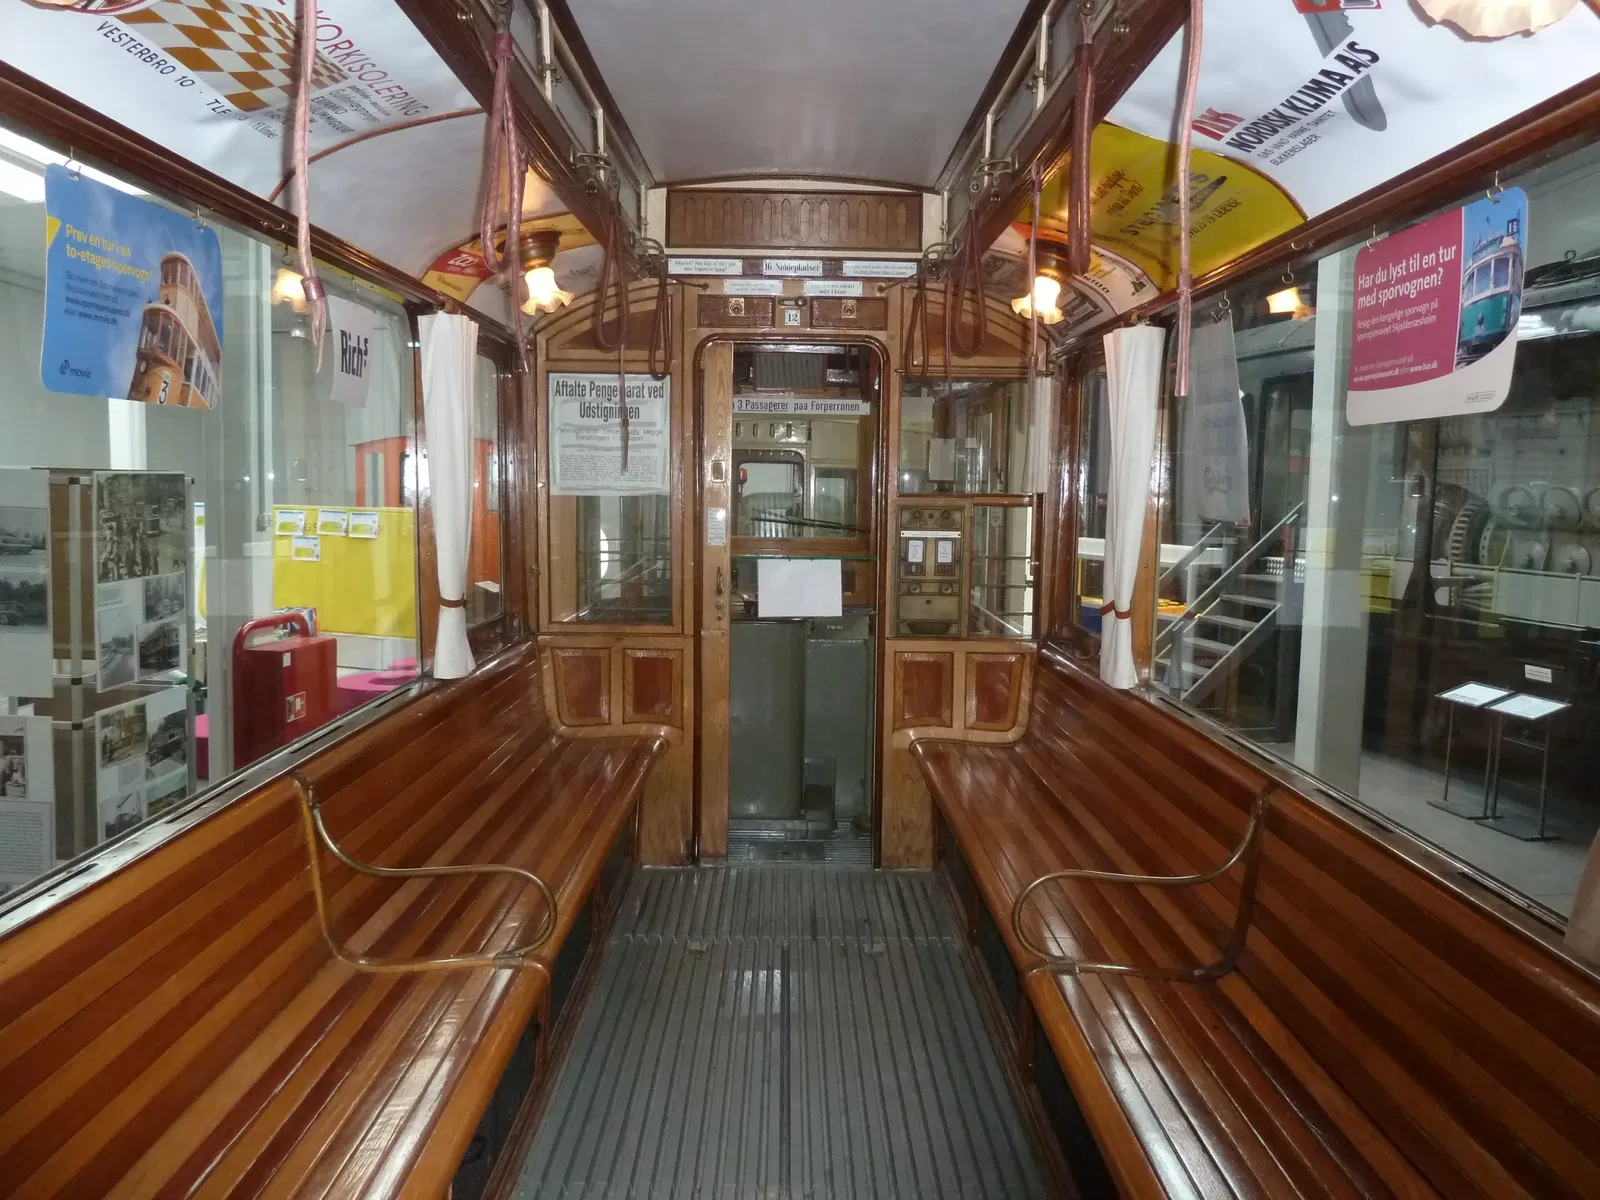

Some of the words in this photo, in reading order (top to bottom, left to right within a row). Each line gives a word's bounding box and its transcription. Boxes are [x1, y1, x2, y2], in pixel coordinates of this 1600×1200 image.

[96, 21, 177, 75] VESTERBRO
[174, 75, 196, 87] 10
[1224, 107, 1303, 154] NORDISK
[1279, 68, 1355, 116] KLIMA
[1333, 40, 1380, 75] A/S
[65, 223, 88, 244] Prøv
[88, 234, 101, 249] en
[102, 237, 115, 253] tur
[119, 244, 132, 258] en
[65, 243, 112, 272] to-etages
[111, 259, 153, 284] sporvogn!
[764, 263, 772, 271] 16
[775, 263, 820, 274] Siddepladser
[1358, 270, 1375, 291] Har
[1375, 265, 1388, 283] du
[1389, 260, 1407, 281] lyst
[1408, 253, 1421, 272] til
[1422, 252, 1436, 268] en
[1438, 245, 1457, 263] tur
[1357, 287, 1378, 310] med
[1378, 270, 1444, 307] sporvognen?
[788, 313, 798, 322] 12
[1370, 315, 1380, 325] den
[1404, 304, 1430, 319] sporvogn
[1430, 297, 1439, 312] på
[70, 366, 92, 379] movia
[158, 380, 170, 405] 3
[554, 380, 587, 398] Aftalte
[589, 380, 618, 401] Penge
[625, 382, 646, 399] arat
[647, 382, 664, 399] ved
[737, 400, 743, 410] 3
[745, 400, 789, 412] Passagerer
[794, 402, 808, 411] paa
[811, 401, 860, 412] Forperronen
